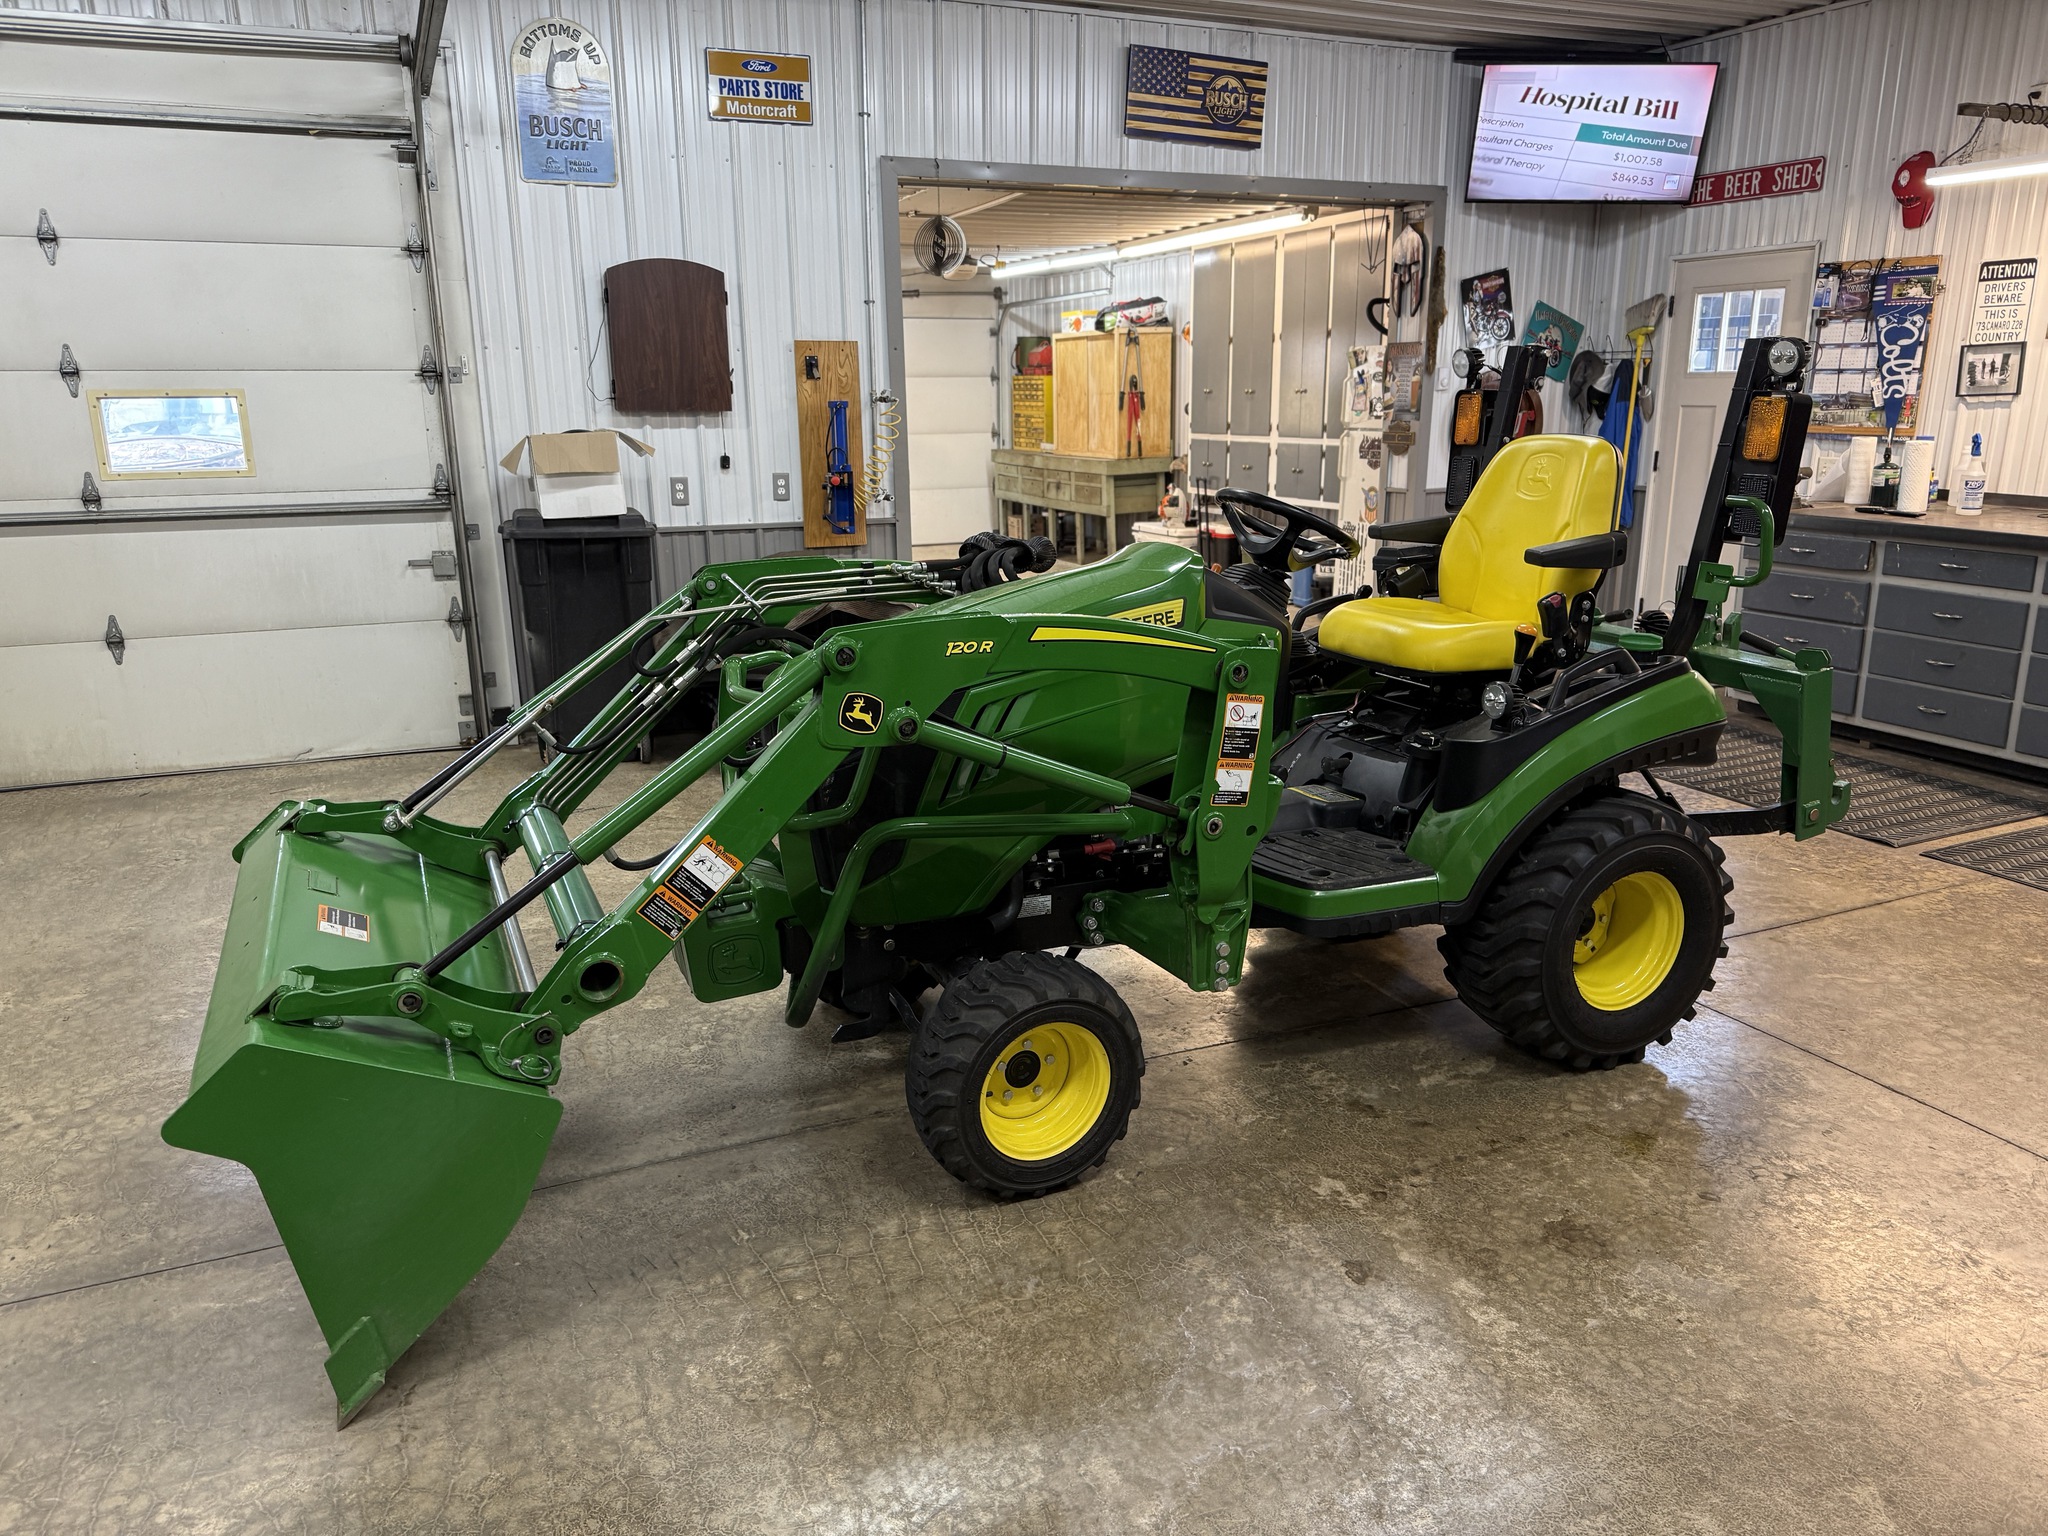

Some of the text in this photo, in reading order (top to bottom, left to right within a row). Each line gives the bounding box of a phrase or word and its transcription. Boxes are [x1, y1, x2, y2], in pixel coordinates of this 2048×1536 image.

[519, 23, 602, 65] BOTTOMS UP
[747, 59, 771, 72] Ford
[719, 77, 804, 100] PARTS STORE
[1205, 89, 1249, 111] BUSCH
[1519, 86, 1679, 120] Hospital Bill
[726, 100, 797, 118] Motorcraft
[1213, 106, 1239, 116] LIGHT
[528, 114, 603, 141] BUSCH
[1476, 135, 1554, 152] nsultant Charges
[1601, 130, 1688, 149] Total Amount Due
[1504, 156, 1546, 172] Therapy
[1613, 152, 1663, 167] $1,007.58
[569, 166, 598, 174] PARTNER
[1611, 171, 1654, 186] $849.53
[1724, 170, 1761, 199] BEER
[1772, 163, 1813, 192] SHED
[1980, 261, 2036, 280] ATTENTION
[1984, 281, 2026, 294] DRIVERS
[1983, 292, 2023, 305] BEWARE
[1985, 308, 2019, 320] THIS IS
[1986, 320, 2011, 331] CAMARO
[1974, 331, 2021, 343] COUNTRY
[1880, 324, 1919, 399] Colts
[1320, 565, 1335, 573] YET
[1120, 609, 1176, 626] ERE
[945, 640, 979, 657] 120
[1234, 695, 1263, 703] WARNING
[1225, 761, 1253, 769] WARNING
[713, 845, 738, 868] WARNING
[667, 895, 693, 918] WARNING
